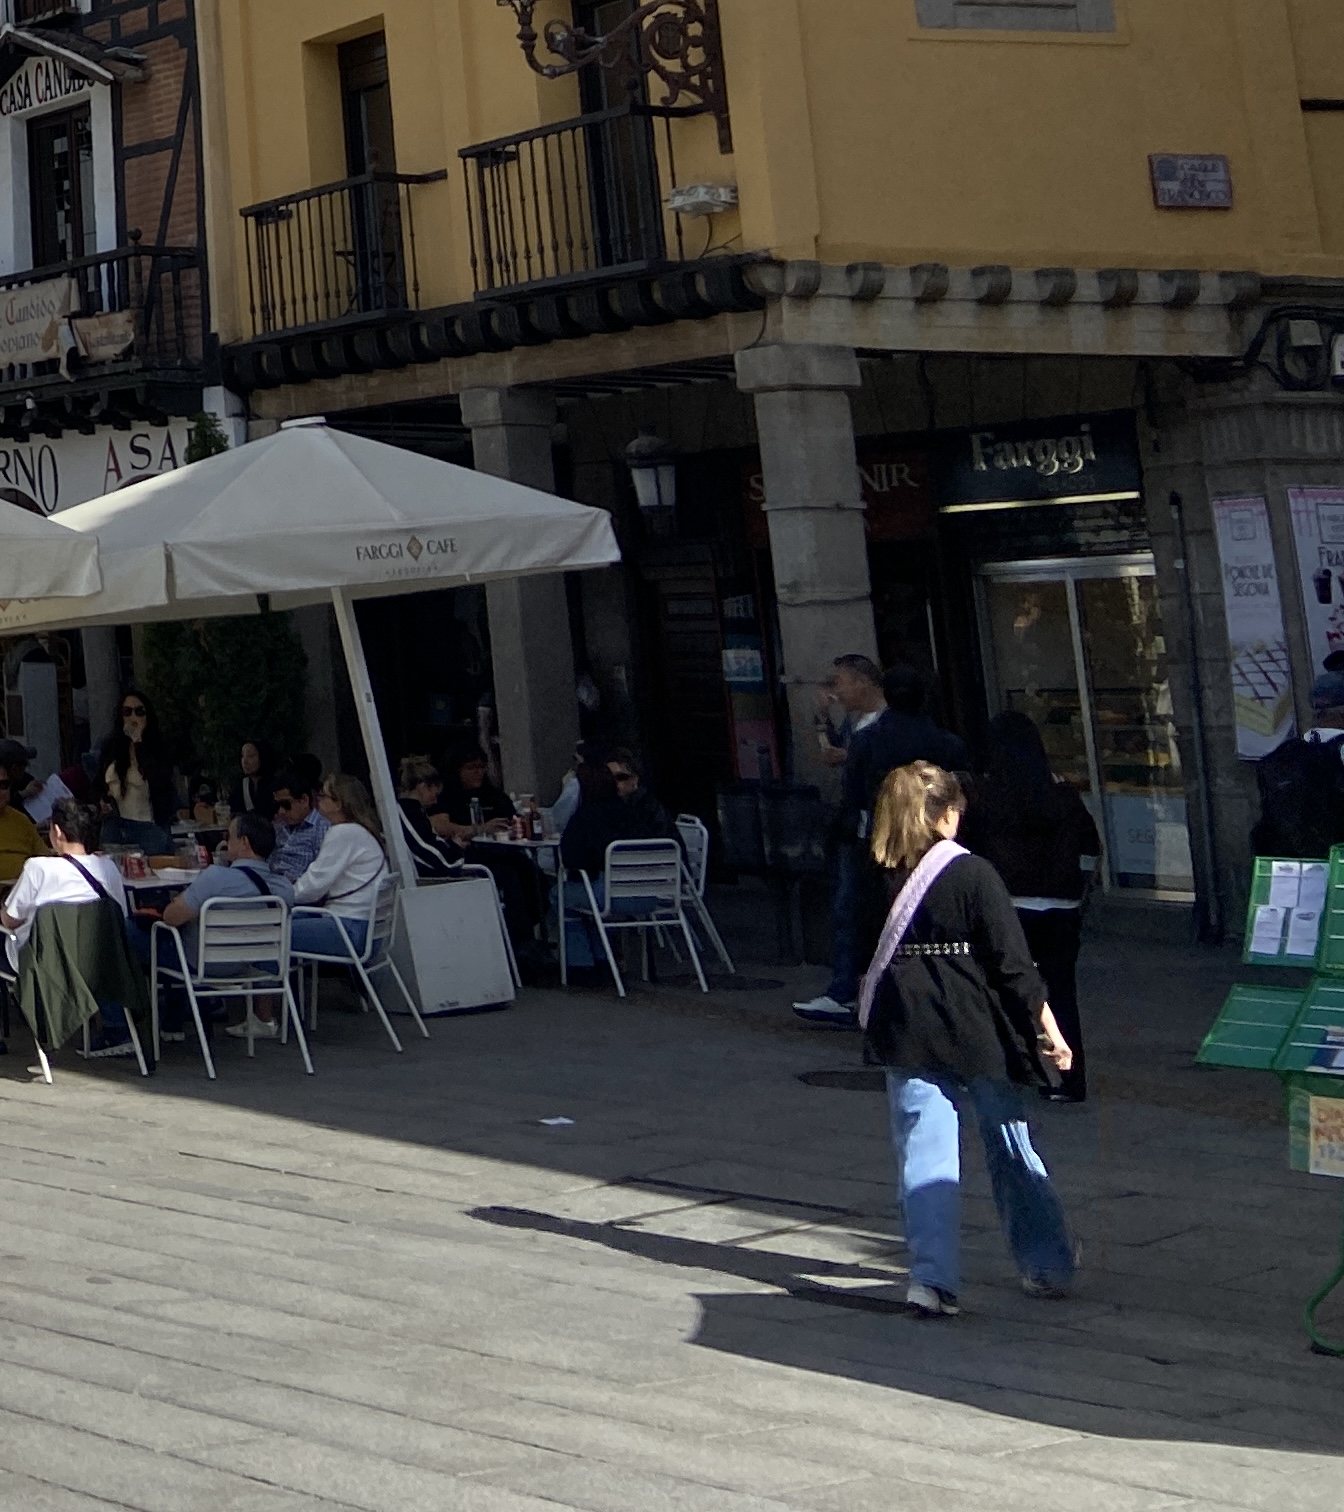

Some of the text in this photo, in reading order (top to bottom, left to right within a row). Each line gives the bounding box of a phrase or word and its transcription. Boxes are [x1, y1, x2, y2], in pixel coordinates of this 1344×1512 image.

[0, 70, 33, 116] CASA
[969, 423, 1096, 476] Farggi
[355, 537, 458, 561] FARGGI CAFE
